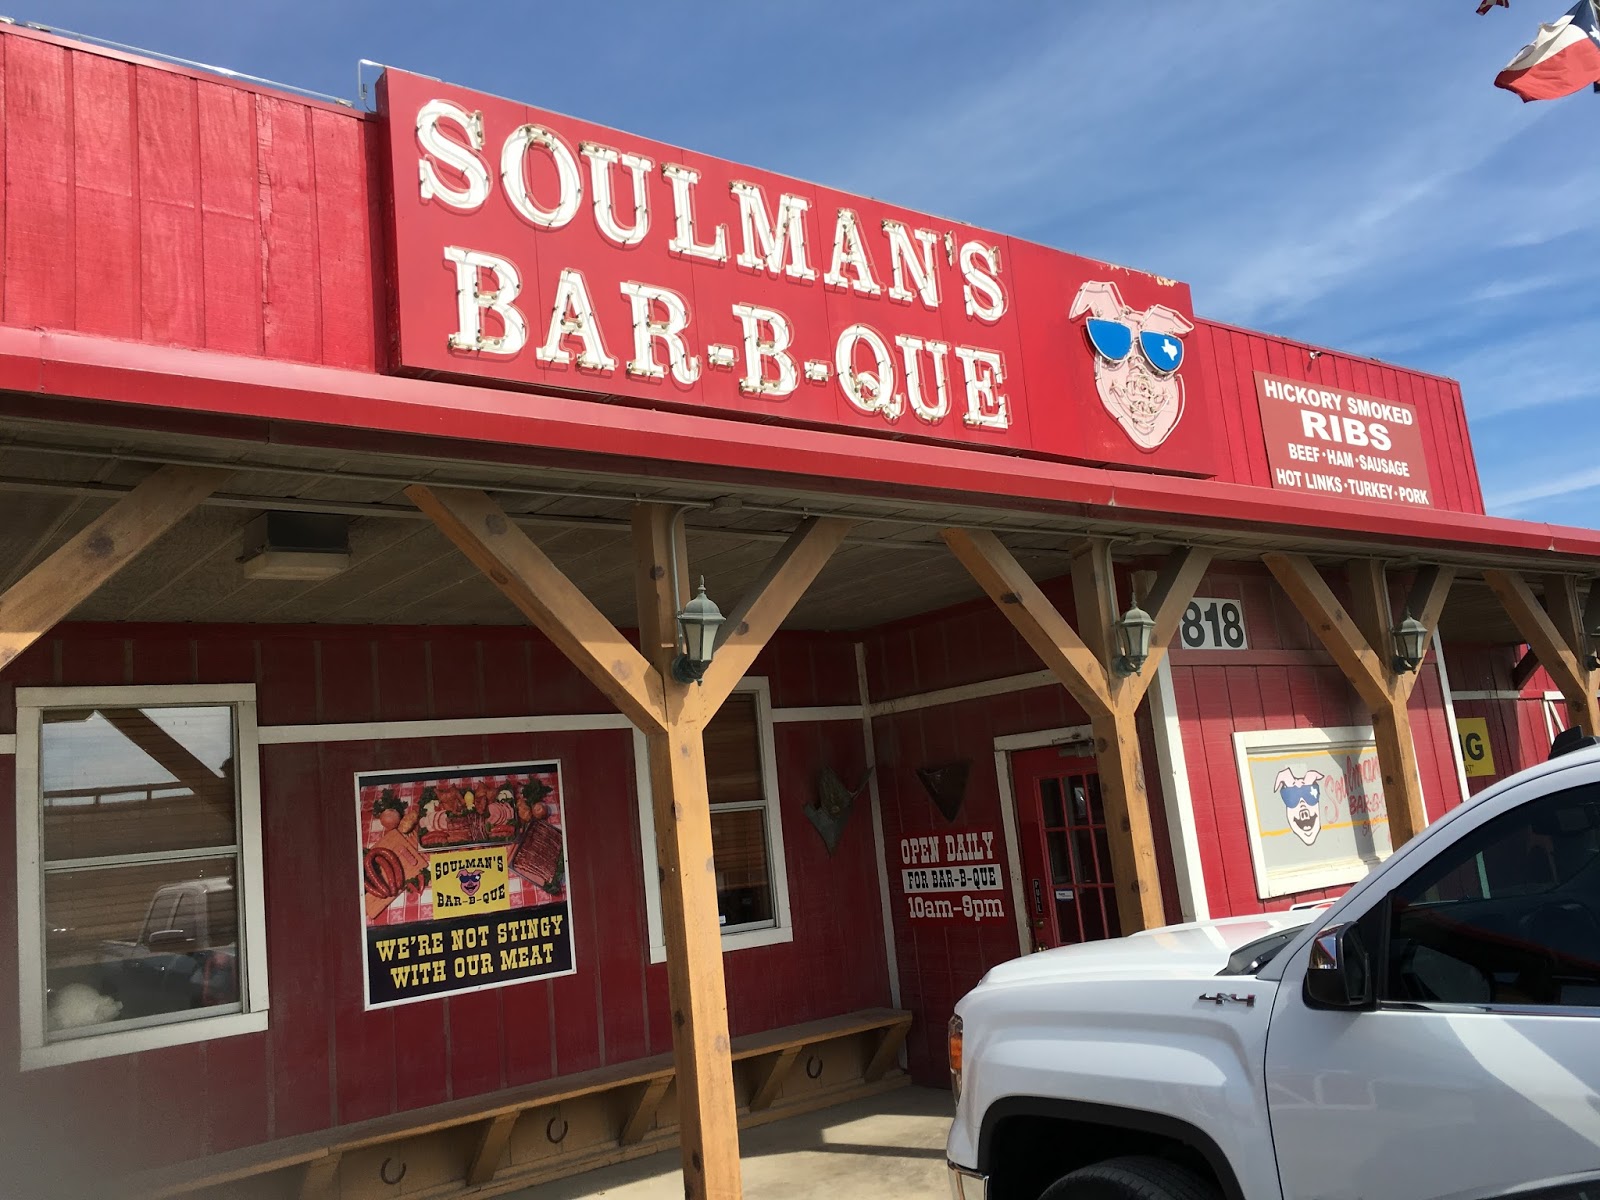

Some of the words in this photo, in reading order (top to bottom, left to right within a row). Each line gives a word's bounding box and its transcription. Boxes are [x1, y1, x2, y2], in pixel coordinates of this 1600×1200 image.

[415, 98, 1008, 322] SOULMAN'S
[443, 245, 1012, 430] BAR-B-QUE
[1264, 379, 1342, 411] HICKORY
[1347, 397, 1413, 426] SMOKED
[1300, 409, 1392, 451] RIBS
[1288, 443, 1320, 463] BEEF
[1327, 449, 1354, 468] HAM
[1359, 455, 1410, 477] SAUSAGE
[1276, 468, 1302, 487] HOT
[1305, 473, 1343, 493] LINKS
[1347, 479, 1393, 500] TURKEY
[1399, 486, 1430, 505] PORK
[1182, 601, 1244, 648] 818
[901, 836, 940, 865] OPEN
[945, 831, 994, 862] DAILY
[435, 855, 504, 881] SOULMAN'S
[908, 870, 929, 889] FOR
[931, 867, 996, 890] BAR-B-QUE
[437, 883, 506, 908] BAR-B-QUE
[908, 895, 1005, 922] 10am-9pm
[1034, 880, 1043, 911] PULL
[376, 932, 443, 962] WE'RE
[451, 925, 490, 951] NOT
[497, 914, 563, 944] STINGY
[390, 960, 447, 989] WITH
[454, 952, 494, 979] OUR
[501, 943, 554, 971] MEAT
